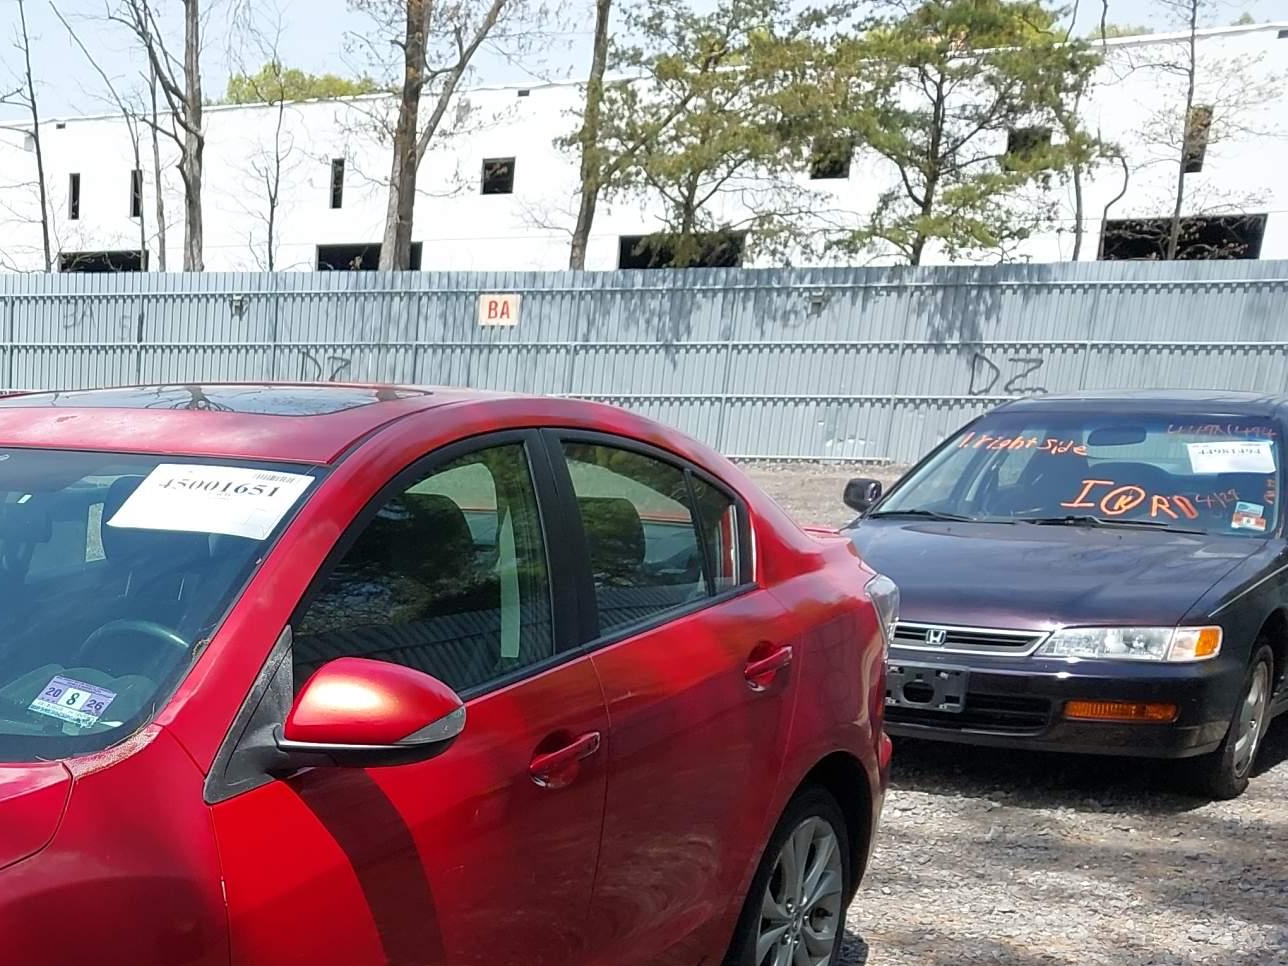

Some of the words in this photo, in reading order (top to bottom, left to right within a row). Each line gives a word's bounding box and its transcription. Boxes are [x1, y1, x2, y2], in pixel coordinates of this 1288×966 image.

[487, 300, 510, 319] BA
[968, 352, 1048, 396] DZ
[159, 478, 280, 497] 45001651
[45, 687, 62, 698] 20
[66, 692, 80, 706] 8
[86, 699, 105, 711] 26
